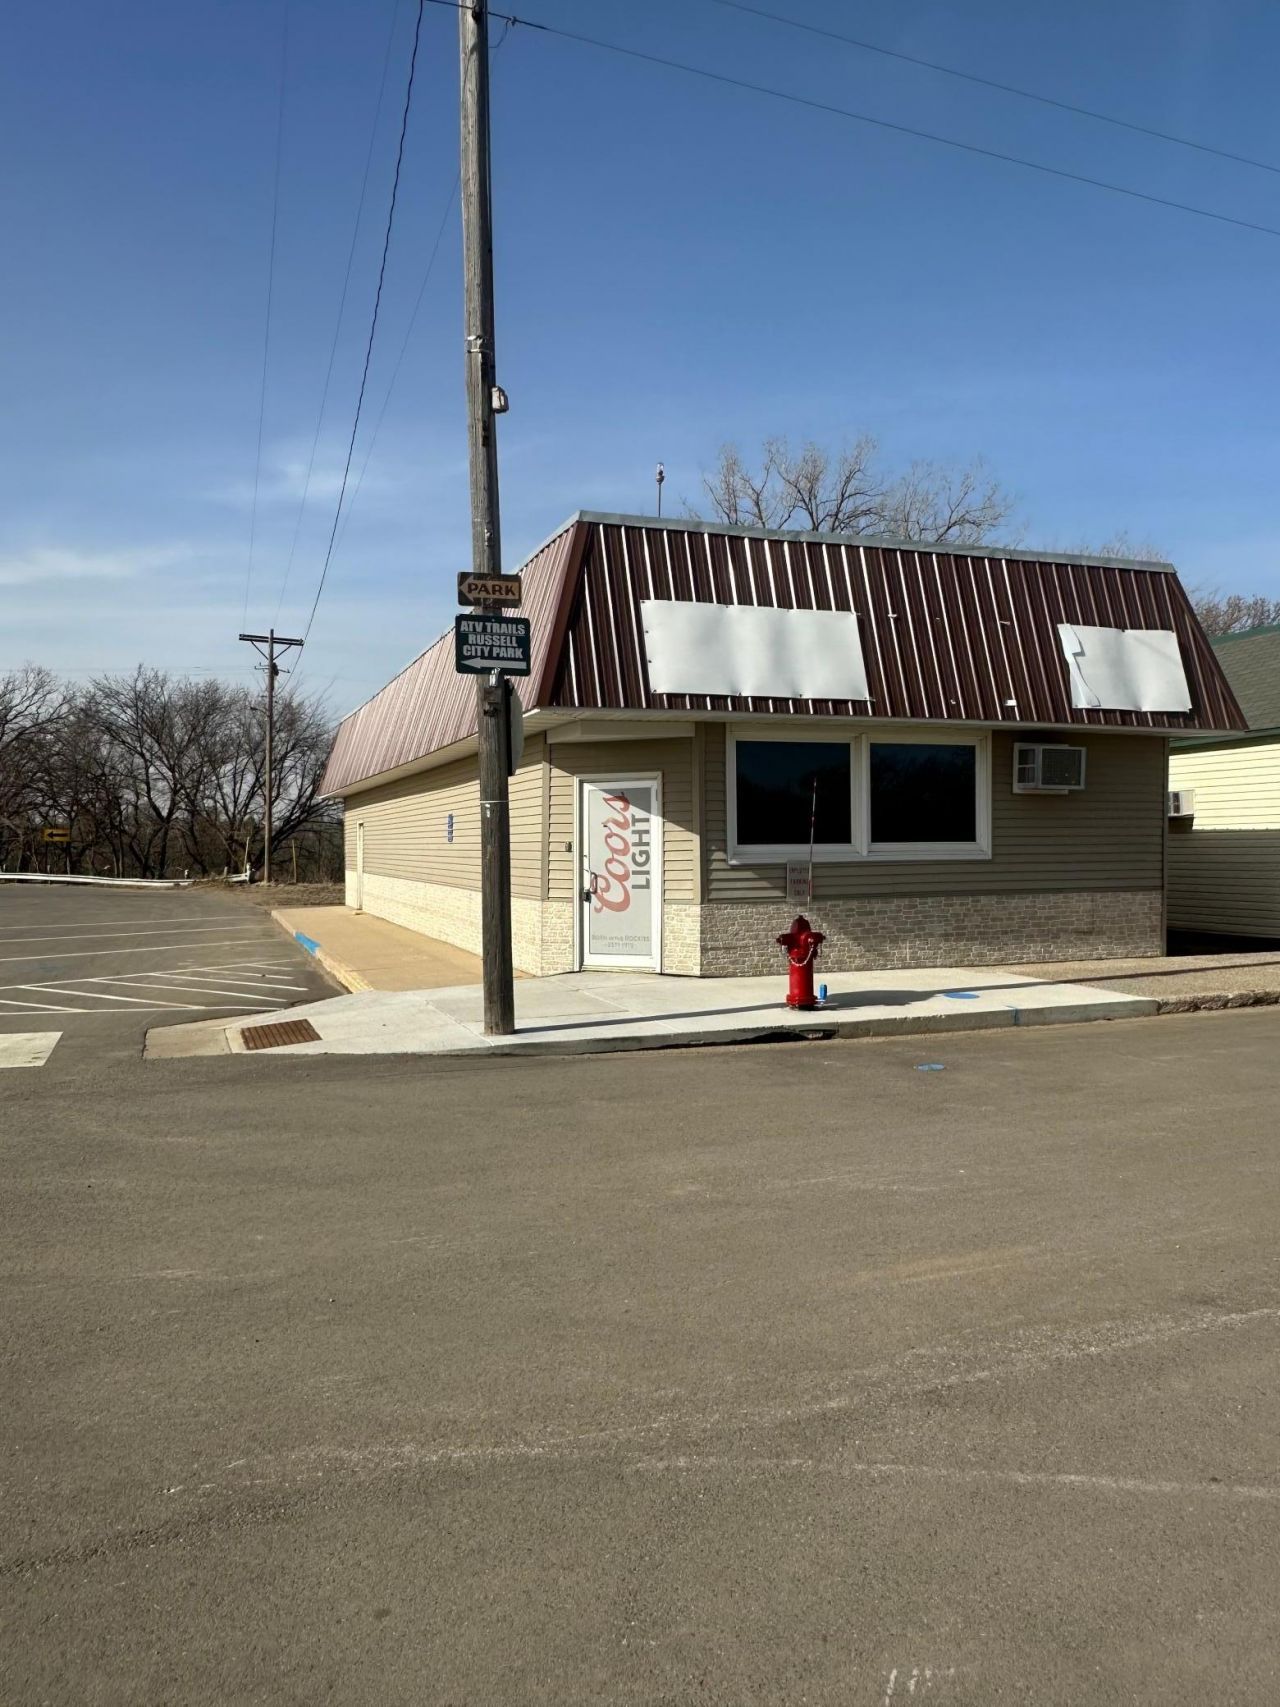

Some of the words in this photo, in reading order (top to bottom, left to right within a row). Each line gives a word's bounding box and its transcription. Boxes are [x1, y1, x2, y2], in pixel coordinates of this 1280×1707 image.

[467, 582, 516, 595] PARK
[460, 620, 483, 632] ATV
[485, 622, 526, 635] TRAILS
[468, 633, 518, 647] RUSSELL
[463, 645, 490, 657] CITY
[492, 647, 523, 659] PARK
[591, 792, 631, 913] Coors
[631, 813, 651, 890] LIGHT
